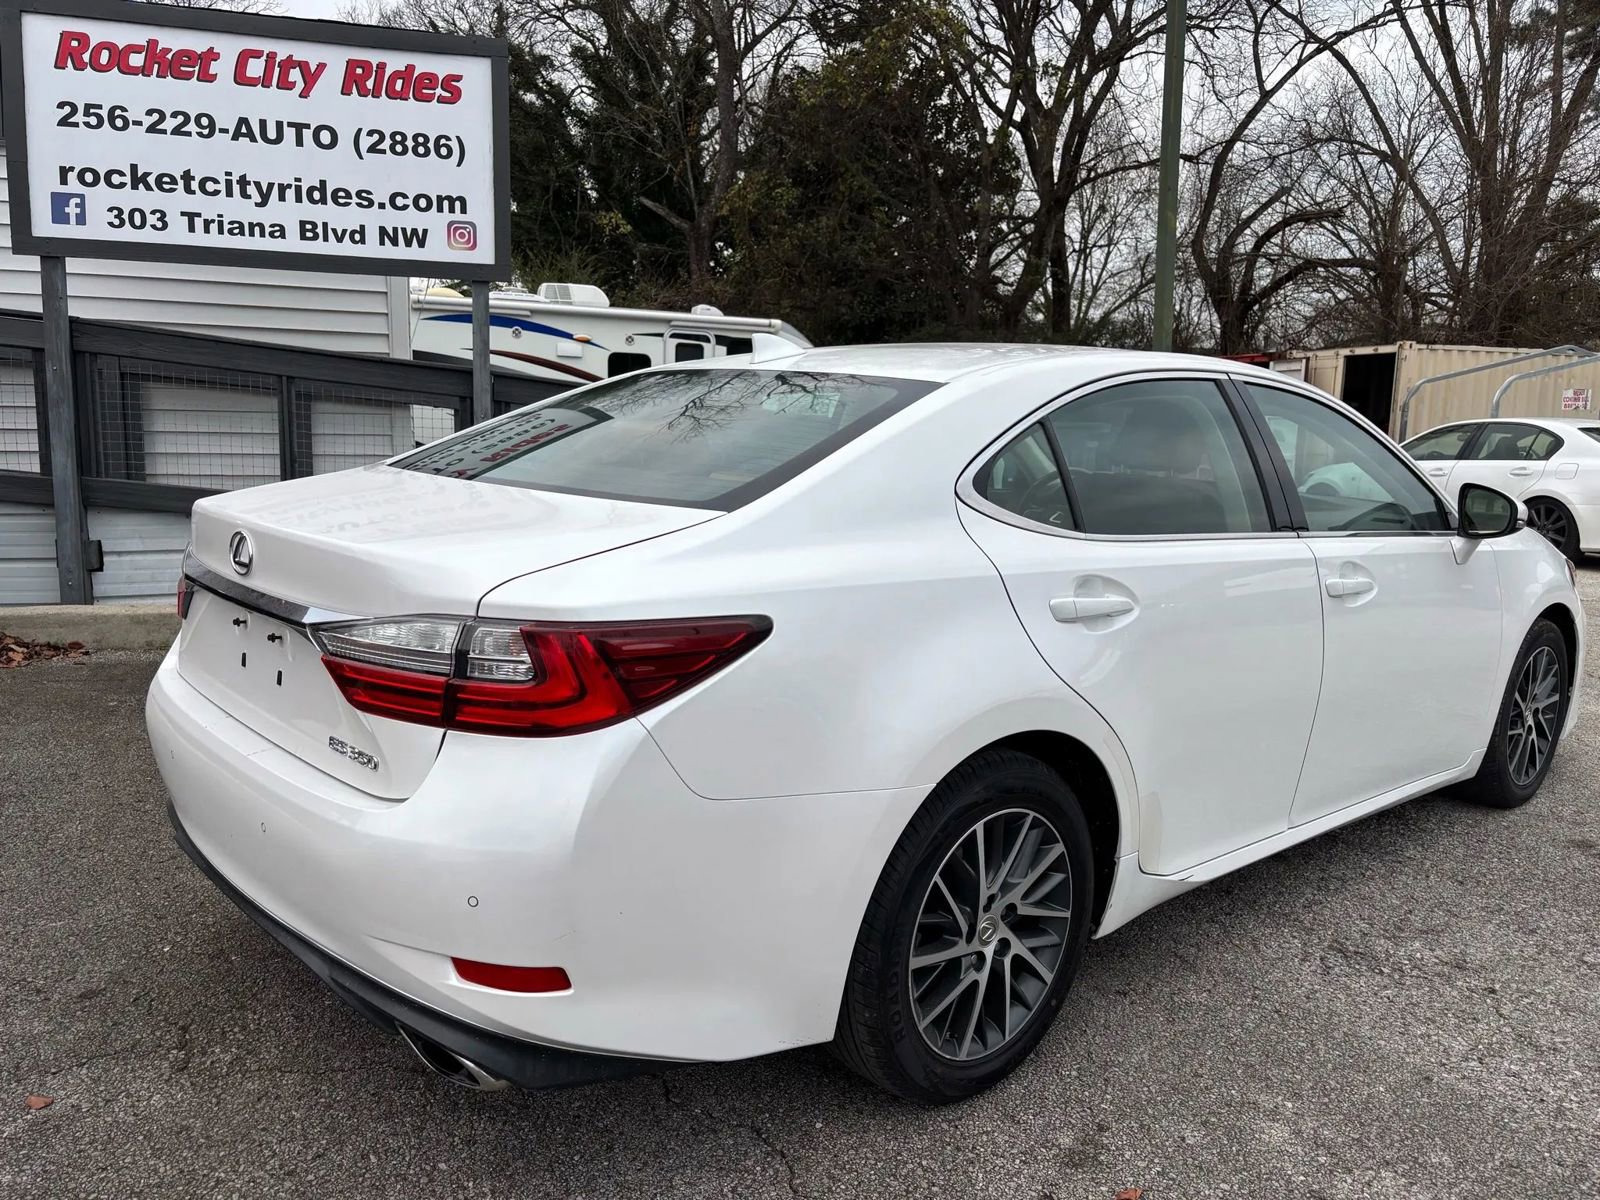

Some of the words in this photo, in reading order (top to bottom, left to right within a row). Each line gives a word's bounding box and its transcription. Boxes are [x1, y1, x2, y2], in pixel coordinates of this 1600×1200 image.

[54, 31, 220, 83] Rocket
[234, 49, 327, 99] City
[341, 59, 463, 104] Rides
[56, 101, 339, 150] 256-229-AUTO
[353, 128, 466, 167] (2886)
[58, 163, 468, 214] rocketcityrides.com
[107, 206, 169, 231] 303
[180, 211, 286, 240] Triana
[299, 220, 366, 245] Blvd
[379, 226, 429, 248] NW
